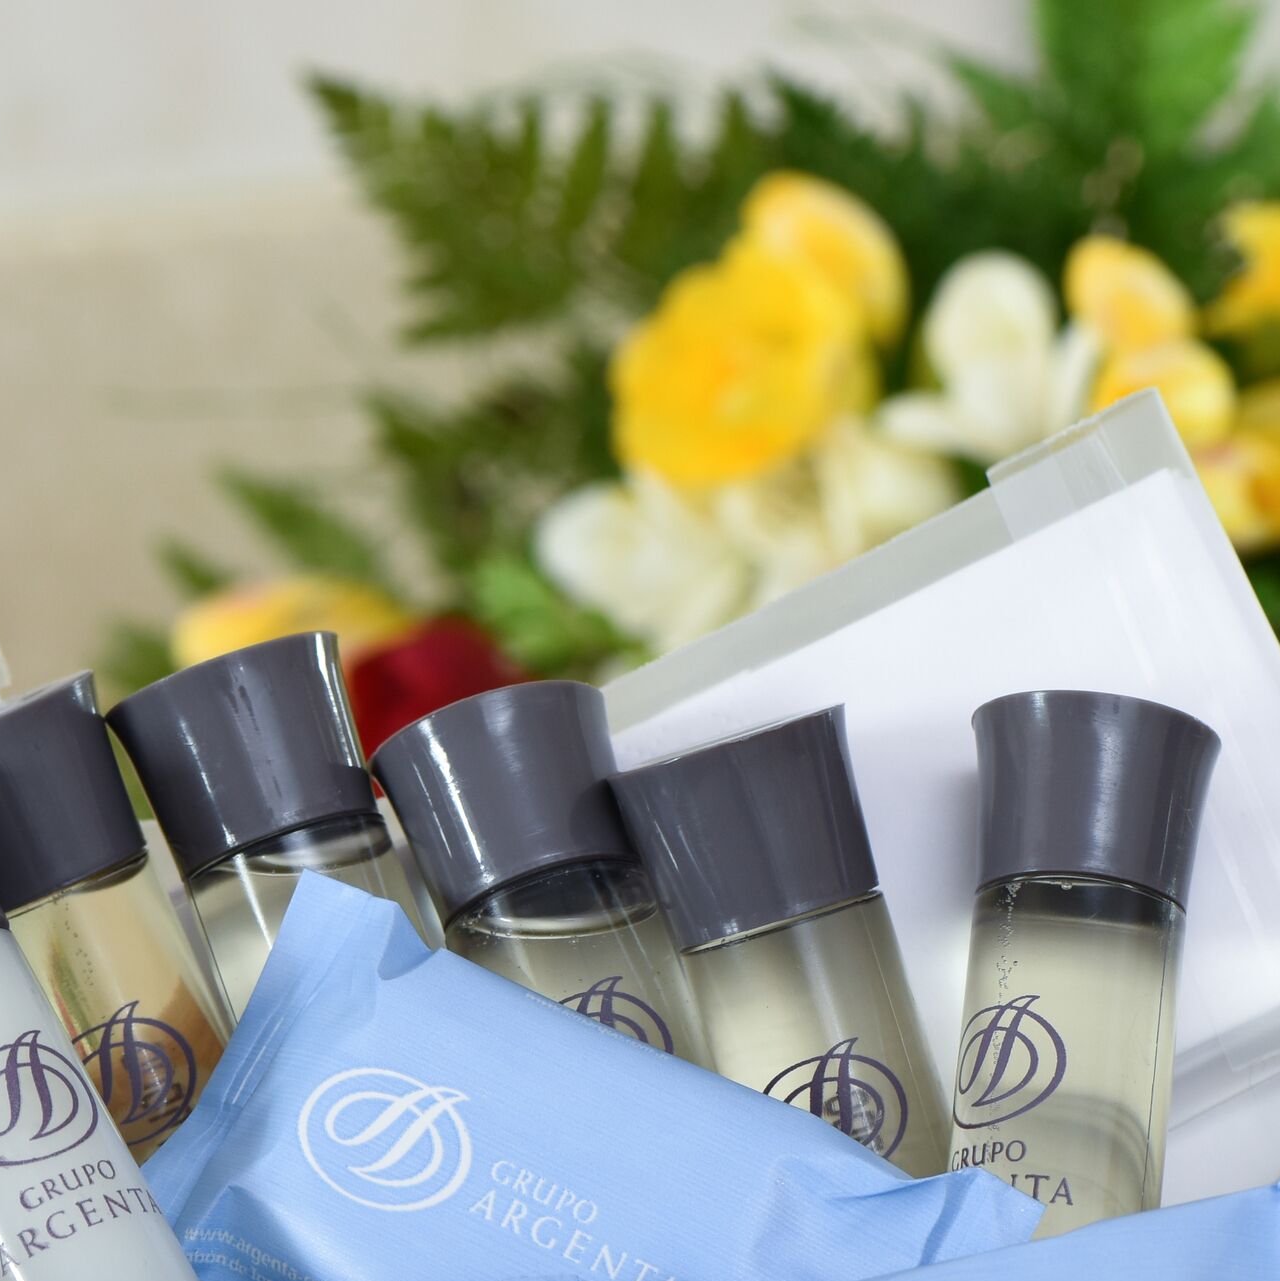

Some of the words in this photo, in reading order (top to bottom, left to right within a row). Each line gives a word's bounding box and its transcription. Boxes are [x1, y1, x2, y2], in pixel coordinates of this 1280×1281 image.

[951, 1140, 1027, 1172] GRUPO
[19, 1159, 116, 1212] GRUPO
[490, 1159, 599, 1225] GRUPO
